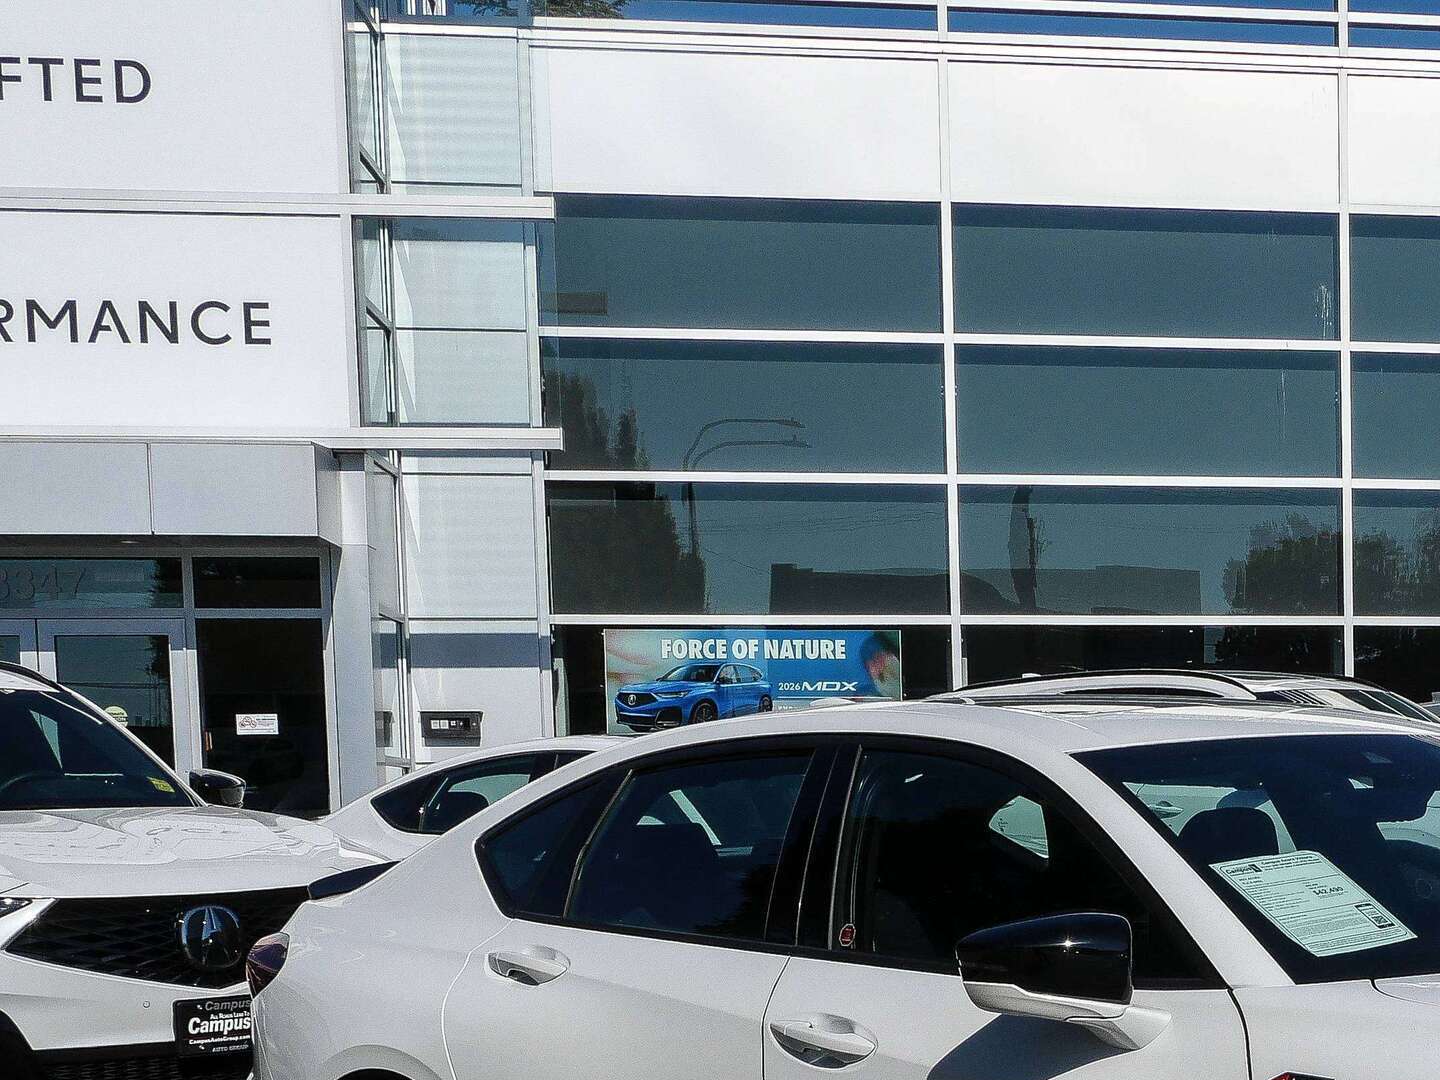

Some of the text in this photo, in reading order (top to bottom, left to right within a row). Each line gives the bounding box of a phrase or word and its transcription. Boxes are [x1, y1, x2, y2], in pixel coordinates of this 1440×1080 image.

[0, 57, 152, 103] FTED
[661, 638, 847, 661] FORCE OF NATURE
[778, 681, 859, 692] 2026 MDX
[188, 1017, 251, 1034] Campus
